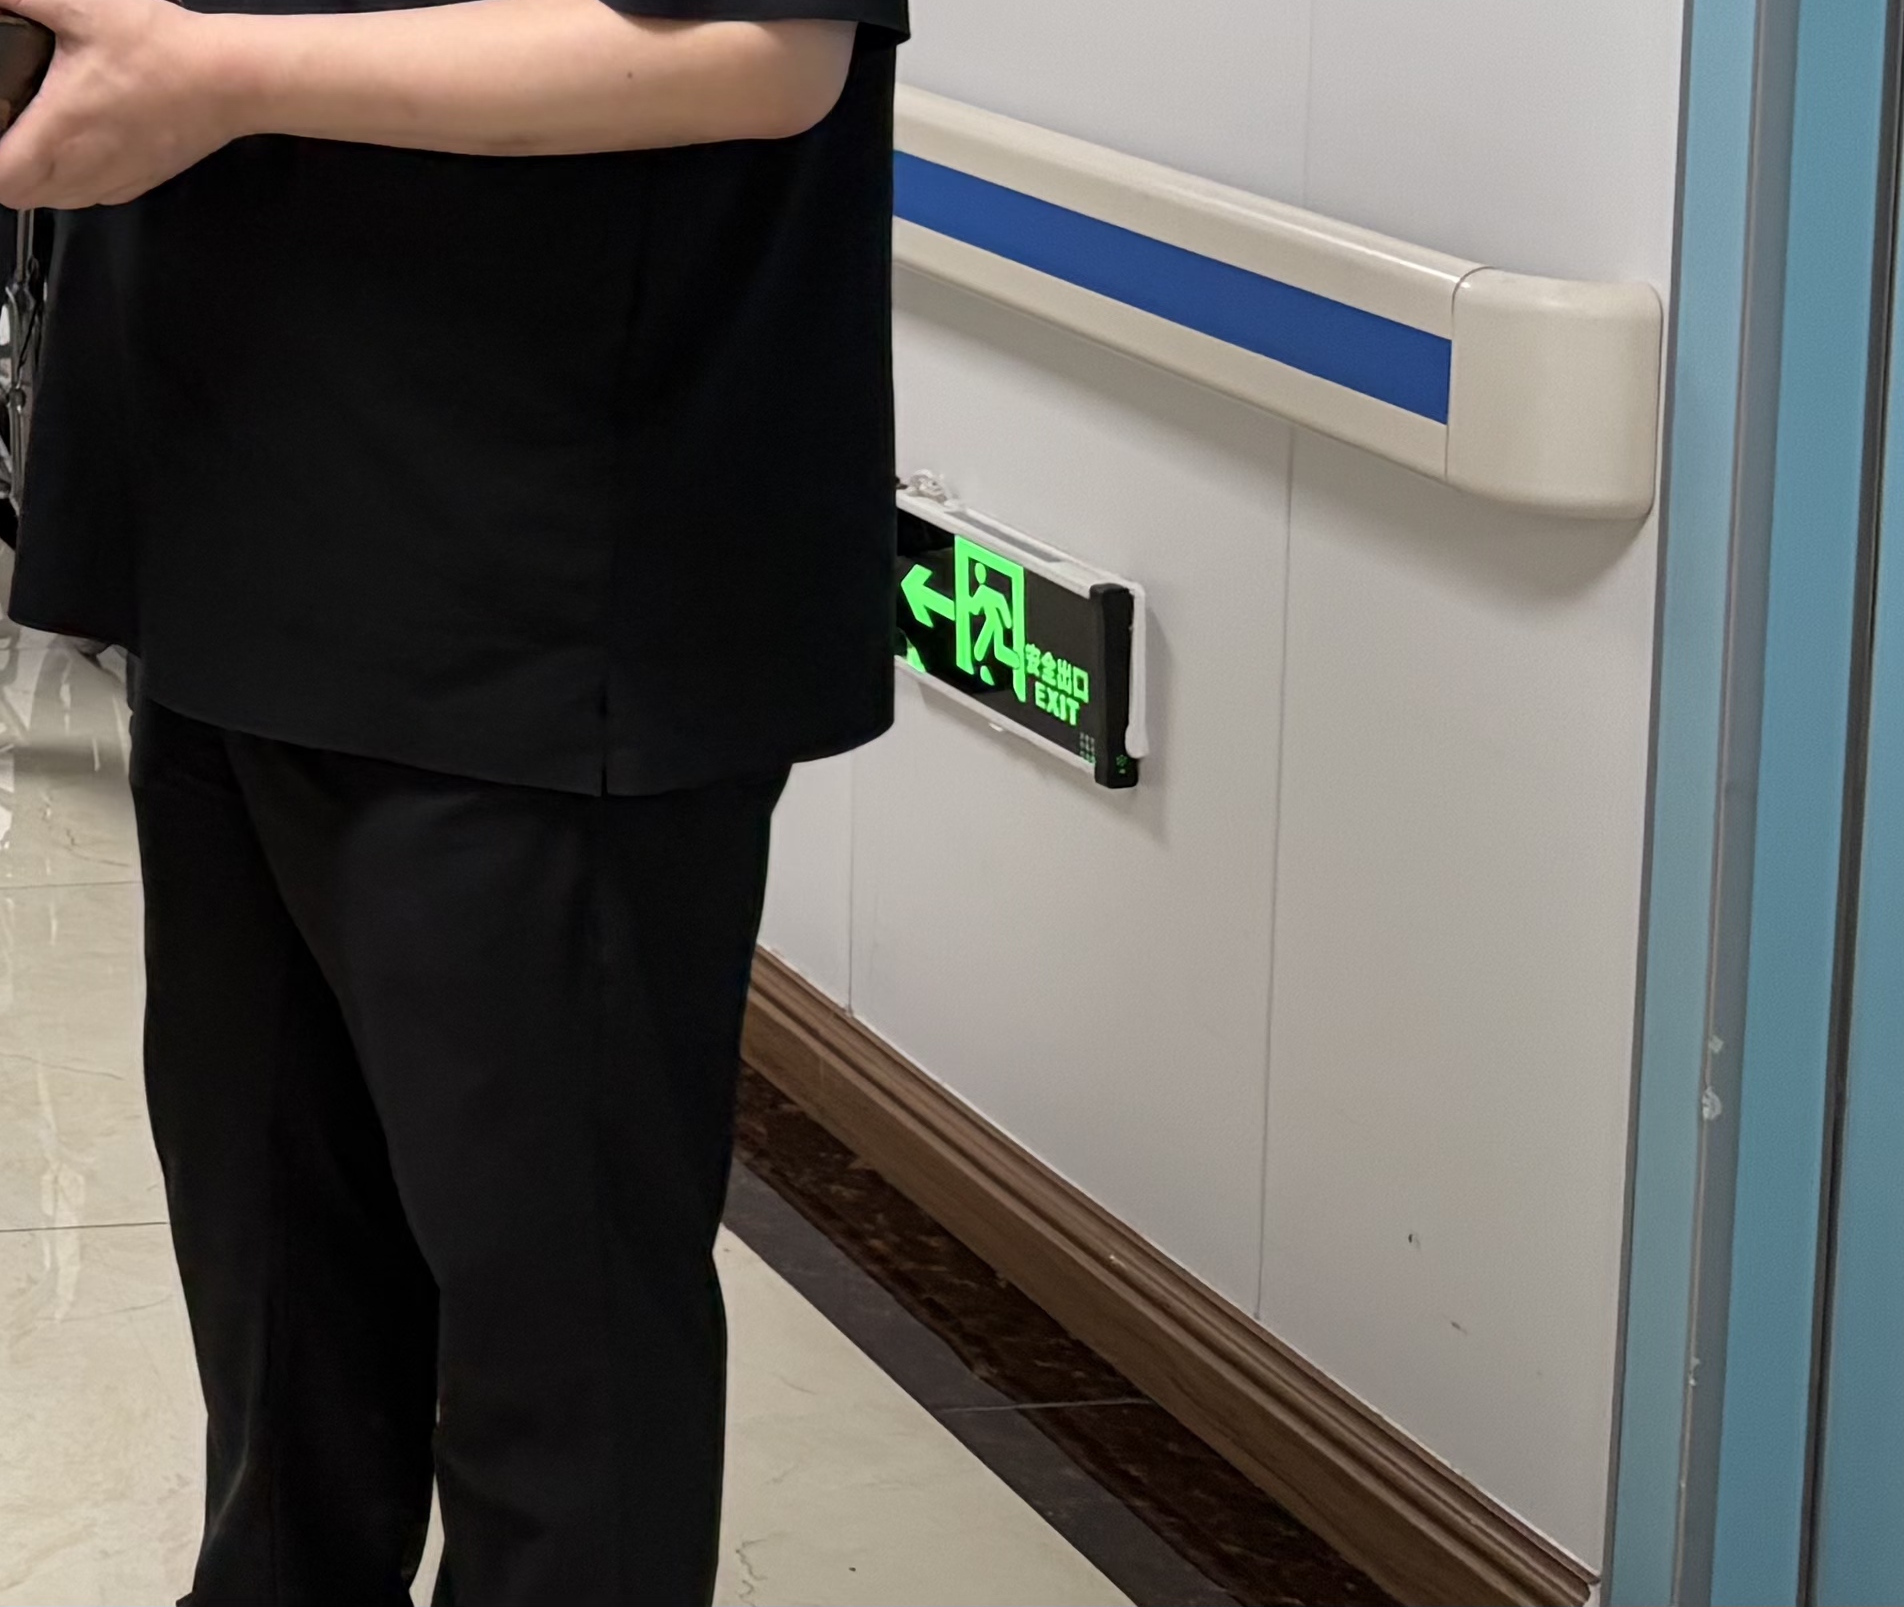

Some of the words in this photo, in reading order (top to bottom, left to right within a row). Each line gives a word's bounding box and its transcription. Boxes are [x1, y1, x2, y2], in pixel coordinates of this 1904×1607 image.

[1025, 643, 1090, 704] 安全出口
[1034, 680, 1081, 726] EXIT
